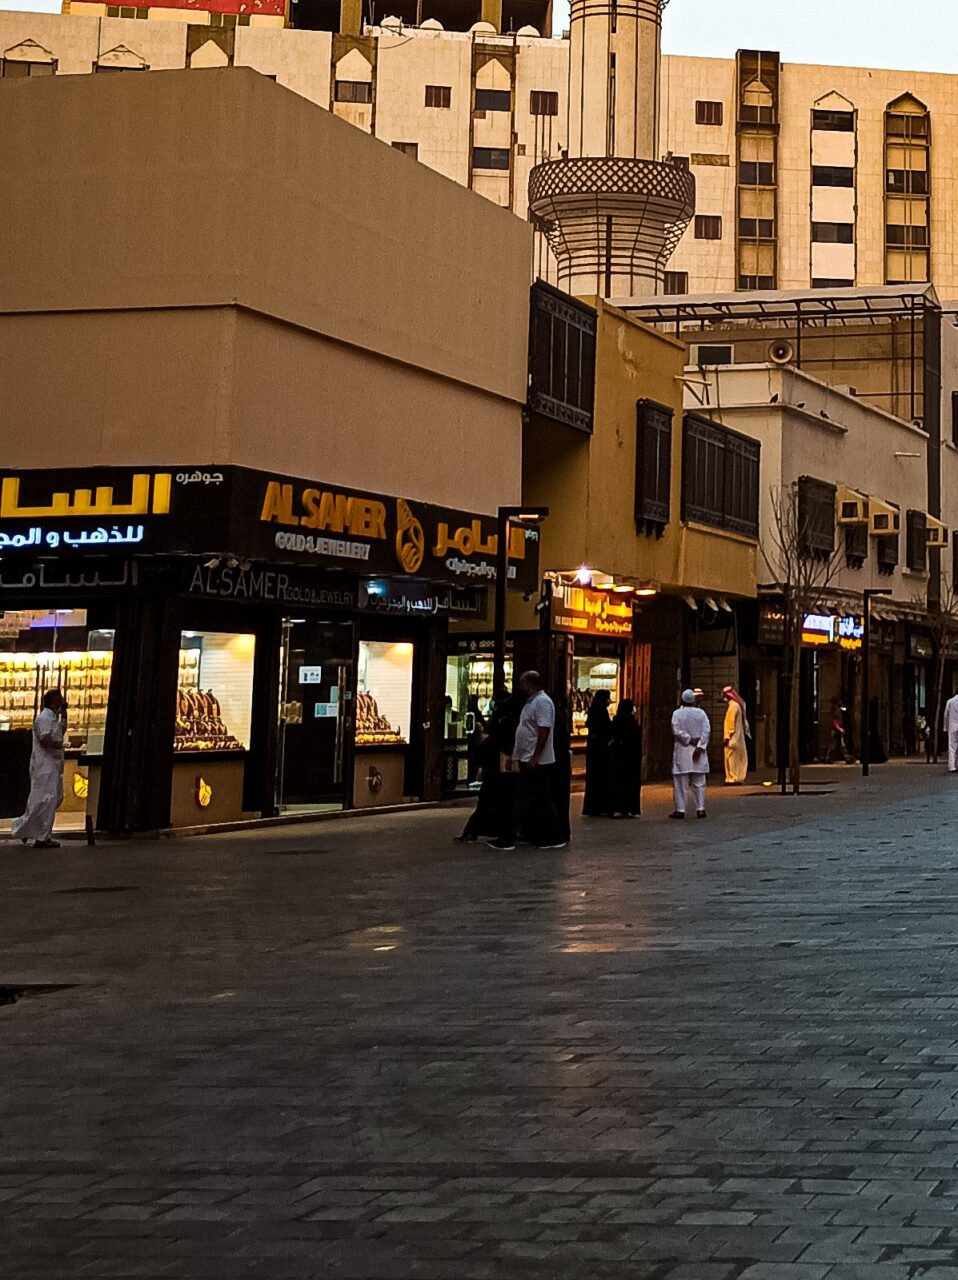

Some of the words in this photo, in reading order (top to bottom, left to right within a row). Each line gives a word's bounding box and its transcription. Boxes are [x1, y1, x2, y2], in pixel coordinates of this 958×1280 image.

[63, 524, 145, 549] للذهب
[274, 531, 305, 552] GOLD
[0, 560, 139, 588] السام
